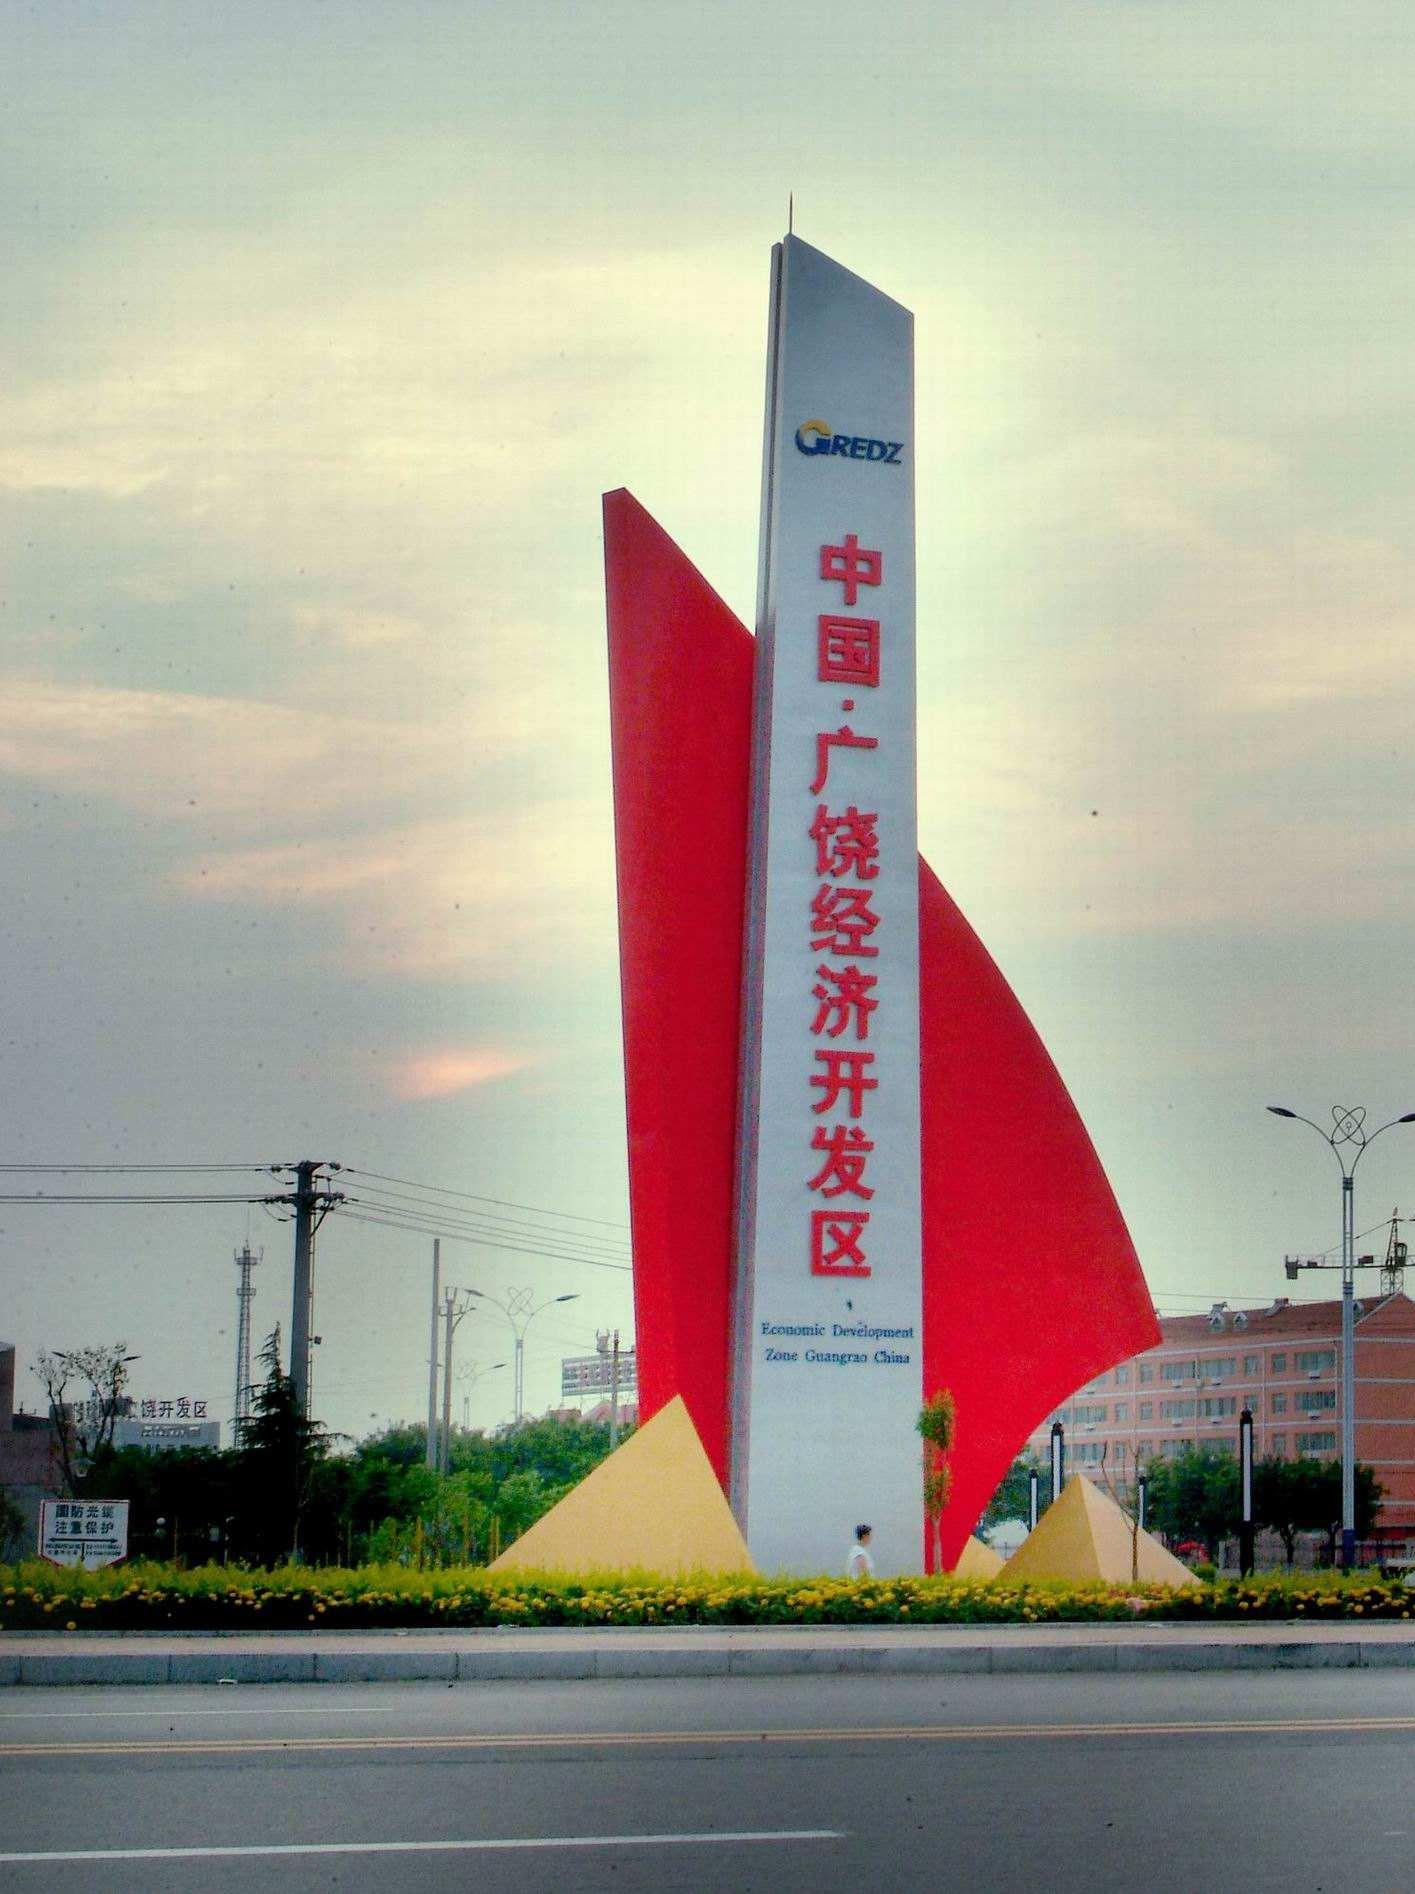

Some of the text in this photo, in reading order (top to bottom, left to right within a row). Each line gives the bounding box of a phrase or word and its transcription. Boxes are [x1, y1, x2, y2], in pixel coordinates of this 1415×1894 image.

[761, 1321, 915, 1340] Economic Development
[765, 1348, 911, 1366] Zone Guangrao China
